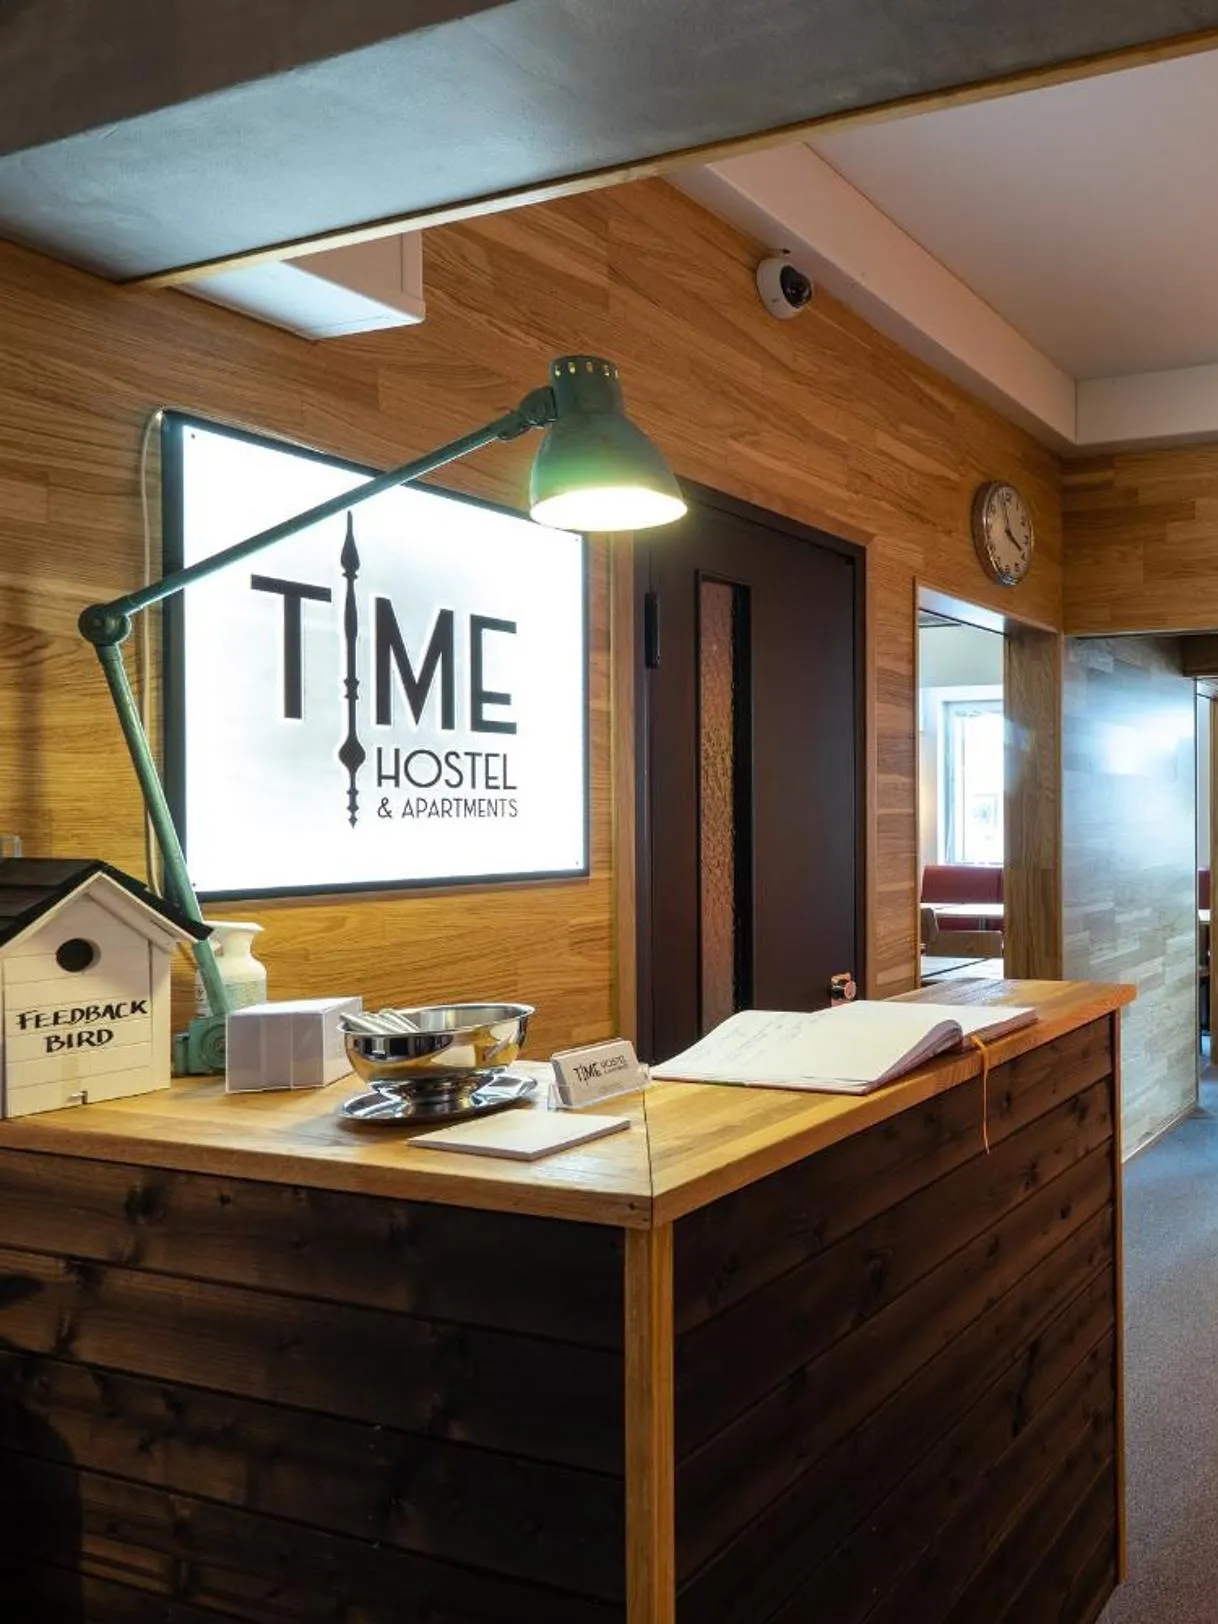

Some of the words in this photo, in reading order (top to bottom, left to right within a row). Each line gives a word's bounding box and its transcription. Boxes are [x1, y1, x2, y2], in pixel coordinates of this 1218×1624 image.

[251, 511, 517, 828] TIME
[377, 747, 517, 790] HOSTEL
[377, 797, 393, 818] &
[401, 798, 518, 819] APARTMENTS
[17, 999, 148, 1030] FEEDBACK
[45, 1028, 114, 1053] BIRD
